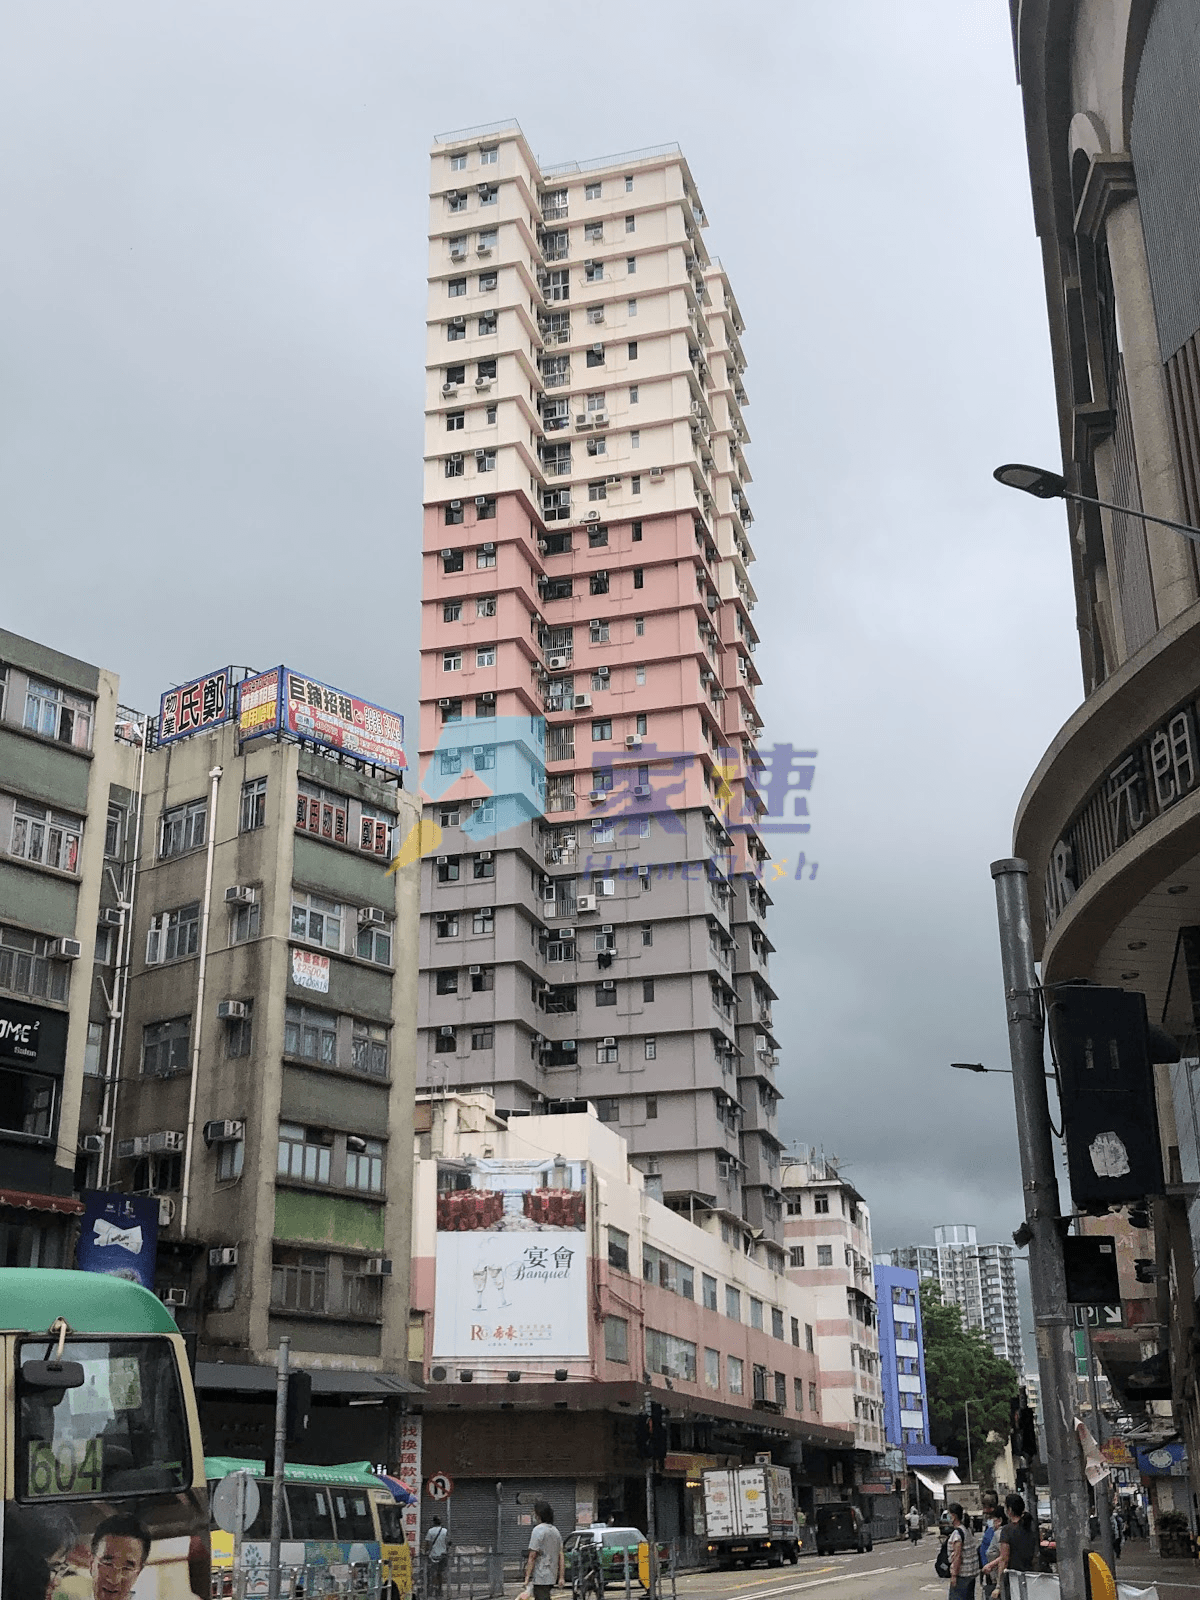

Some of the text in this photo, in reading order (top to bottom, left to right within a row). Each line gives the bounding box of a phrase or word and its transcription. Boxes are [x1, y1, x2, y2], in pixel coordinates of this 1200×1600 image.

[1108, 711, 1195, 849] 元朗
[14, 1046, 37, 1057] Salon
[523, 1245, 575, 1269] 宴會
[506, 1262, 570, 1283] Banquet
[30, 1439, 101, 1494] 604
